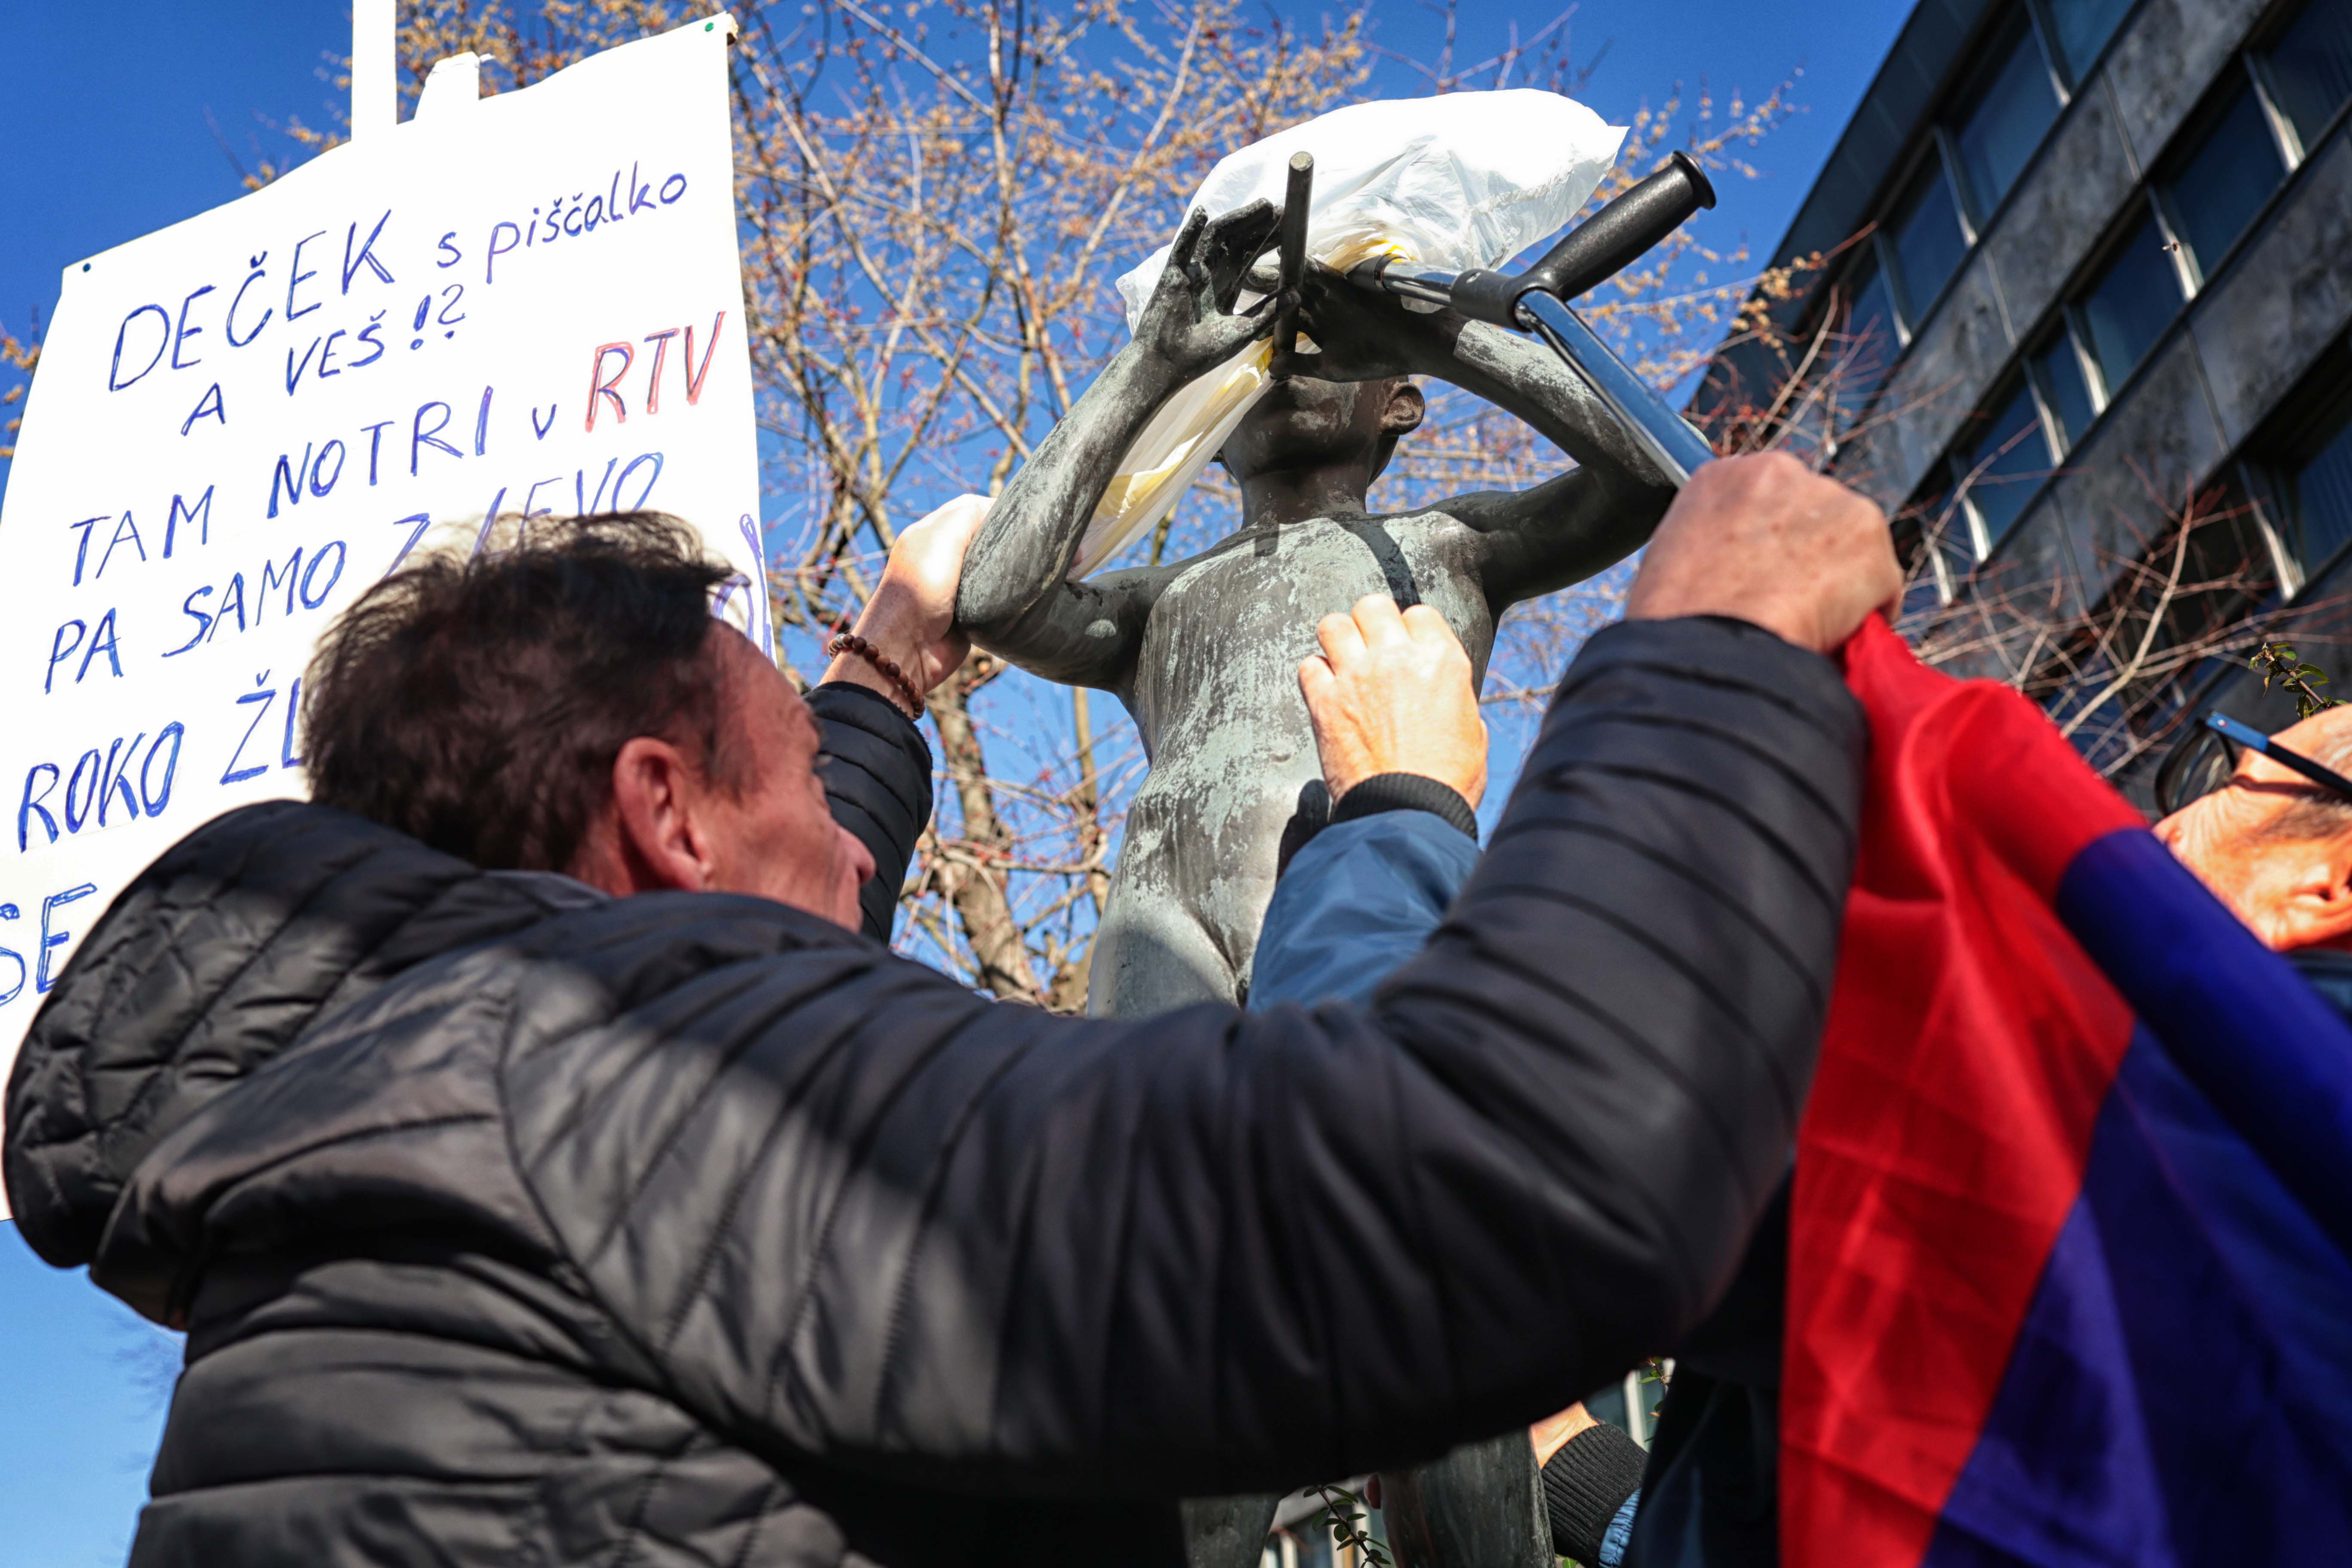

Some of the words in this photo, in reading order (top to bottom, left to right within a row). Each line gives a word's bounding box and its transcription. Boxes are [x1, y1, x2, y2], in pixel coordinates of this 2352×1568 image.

[109, 210, 395, 392] DEČEK
[437, 232, 462, 268] s
[487, 162, 687, 285] piščalko
[71, 484, 214, 587] TAM
[267, 386, 494, 519] NOTRI
[585, 311, 726, 433] RTV
[181, 383, 226, 436] A
[45, 607, 124, 695] PA
[162, 540, 346, 658] SAMO
[18, 720, 185, 853] ROKO
